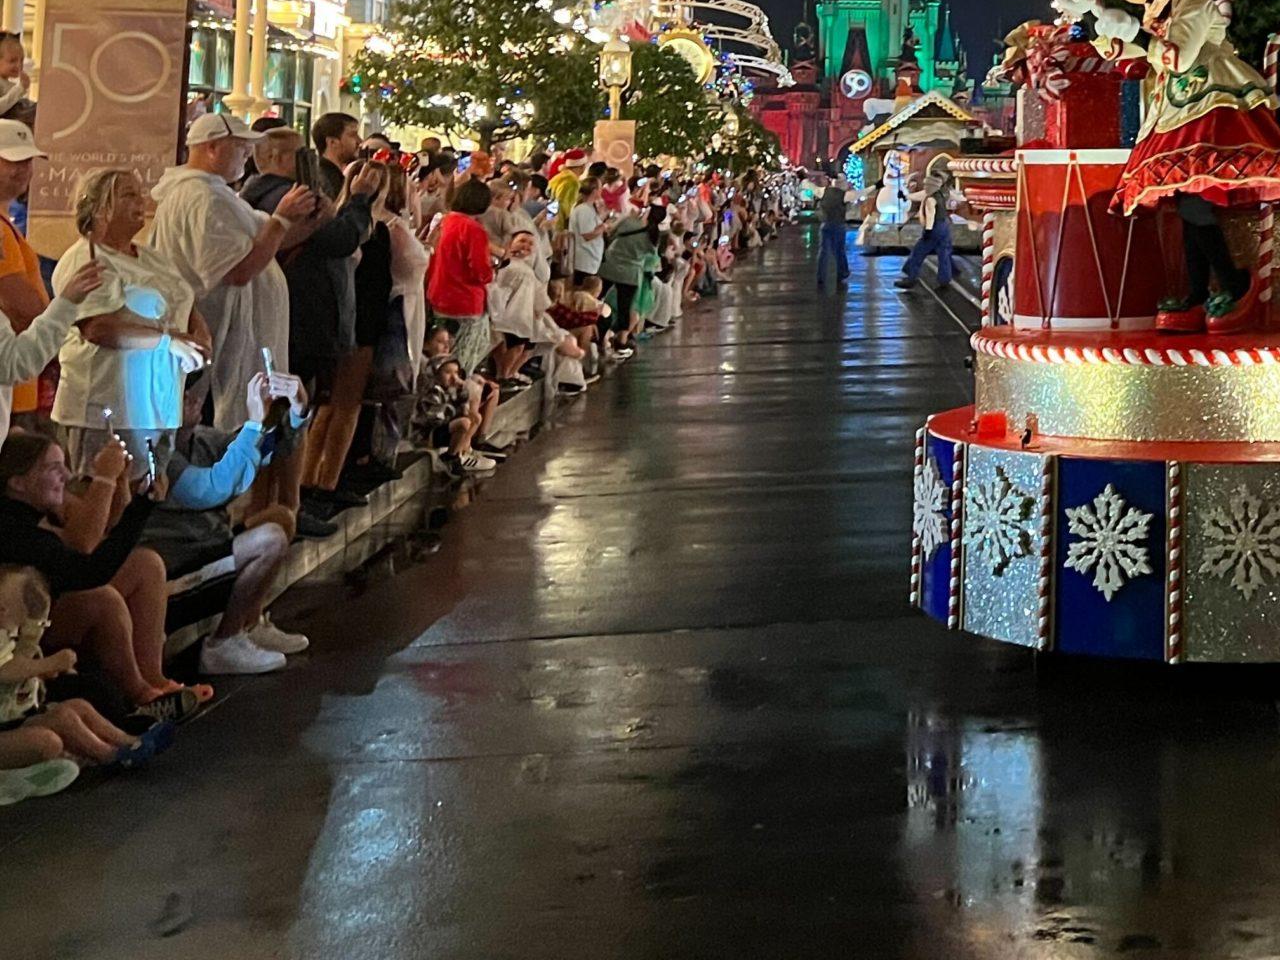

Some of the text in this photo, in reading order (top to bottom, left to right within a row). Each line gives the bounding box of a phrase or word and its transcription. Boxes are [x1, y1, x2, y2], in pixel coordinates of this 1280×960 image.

[52, 23, 171, 140] 50
[846, 73, 869, 98] 50
[69, 152, 126, 163] WORLD'S
